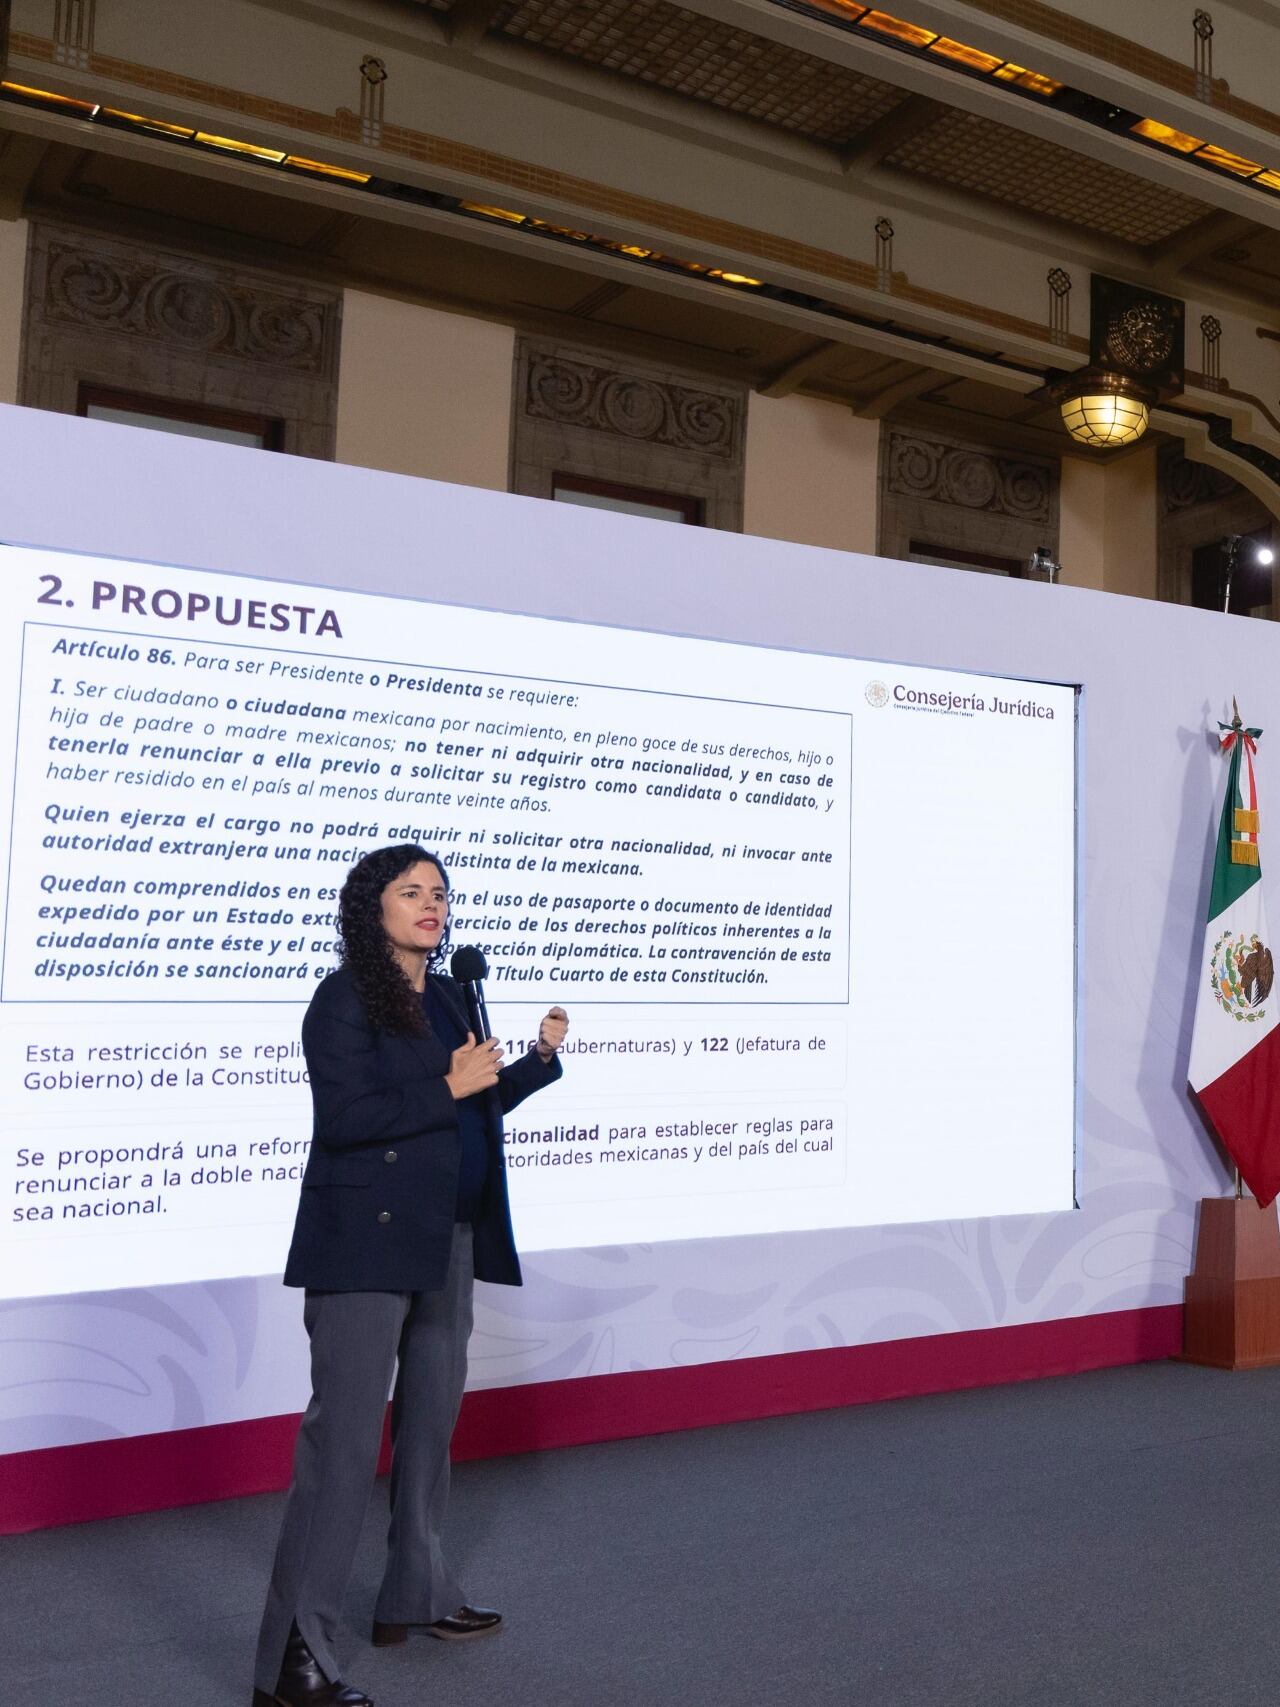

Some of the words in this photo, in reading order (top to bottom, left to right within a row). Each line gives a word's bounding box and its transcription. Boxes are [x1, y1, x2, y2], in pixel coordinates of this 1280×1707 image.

[37, 574, 75, 607] 2.
[92, 581, 343, 638] PROPUESTA
[51, 638, 140, 662] Artículo
[147, 648, 176, 666] 86.
[184, 652, 230, 671] Para
[235, 660, 265, 674] ser
[269, 661, 364, 685] Presidente
[386, 673, 483, 697] Presidenta
[487, 687, 504, 700] se
[509, 690, 579, 708] requiere:
[50, 678, 64, 695] I.
[74, 680, 108, 698] Ser
[114, 685, 219, 708] ciudadano
[244, 697, 347, 720] ciudadana
[352, 710, 436, 728] mexicana
[440, 719, 470, 734] por
[475, 721, 567, 743] nacimiento,
[573, 731, 592, 743] en
[595, 731, 637, 748] pleno
[642, 738, 676, 753] goce
[681, 739, 698, 753] de
[701, 744, 725, 756] sus
[729, 743, 792, 764] derechos,
[797, 750, 822, 768] hijo
[893, 685, 985, 711] Consejería
[989, 697, 1054, 719] Jurídica
[50, 706, 89, 729] hija
[99, 711, 124, 728] de
[133, 716, 193, 734] padre
[225, 724, 287, 741] madre
[296, 731, 396, 753] mexicanos;
[405, 740, 427, 753] no
[436, 741, 484, 757] tener
[491, 746, 509, 760] ni
[515, 748, 584, 768] adquirir
[590, 755, 624, 770] otra
[631, 759, 733, 781] nacionalidad,
[755, 771, 773, 782] en
[779, 773, 811, 785] caso
[817, 774, 833, 788] de
[46, 761, 109, 782] haber
[114, 769, 195, 788] residido
[202, 777, 225, 790] en
[231, 775, 248, 791] el
[251, 778, 291, 796] país
[297, 780, 315, 796] al
[319, 785, 378, 800] menos
[384, 786, 452, 805] durante
[457, 792, 505, 809] veinte
[510, 796, 551, 812] años.
[48, 736, 129, 756] tenerla
[140, 744, 243, 764] renunciar
[275, 752, 312, 770] ella
[320, 758, 381, 775] previo
[410, 763, 485, 782] solicitar
[492, 772, 512, 785] su
[520, 773, 586, 791] registro
[595, 780, 637, 794] como
[646, 783, 722, 801] candidata
[745, 791, 818, 810] candidato,
[42, 834, 154, 853] autoridad
[159, 840, 269, 861] extranjera
[274, 846, 311, 860] una
[444, 851, 512, 870] distinta
[516, 855, 536, 871] de
[541, 857, 557, 871] la
[562, 859, 644, 876] mexicana.
[45, 804, 109, 824] Quien
[120, 808, 186, 830] ejerza
[196, 813, 215, 829] el
[224, 818, 281, 836] cargo
[290, 821, 314, 834] no
[321, 821, 379, 840] podrá
[387, 824, 462, 846] adquirir
[468, 829, 486, 843] ni
[492, 831, 563, 848] solicitar
[569, 836, 604, 850] otra
[610, 838, 714, 859] nacionalidad,
[722, 844, 737, 858] ni
[742, 845, 796, 861] invocar
[801, 850, 832, 863] ante
[40, 875, 126, 894] Quedan
[133, 880, 281, 900] comprendidos
[287, 886, 311, 900] en
[472, 890, 489, 906] el
[493, 894, 523, 907] uso
[528, 892, 548, 908] de
[552, 897, 636, 914] pasaporte
[654, 897, 739, 915] documento
[743, 901, 761, 916] de
[764, 901, 833, 918] identidad
[38, 904, 140, 925] expedido
[146, 909, 185, 927] por
[193, 910, 218, 923] un
[226, 908, 294, 925] Estado
[518, 916, 539, 931] de
[544, 917, 568, 932] los
[574, 918, 647, 934] derechos
[651, 921, 718, 939] políticos
[722, 923, 800, 939] inherentes
[818, 926, 832, 939] la
[36, 931, 160, 950] ciudadanía
[166, 936, 214, 951] ante
[221, 934, 264, 951] éste
[287, 936, 305, 952] el
[542, 942, 643, 961] diplomática.
[648, 944, 667, 959] La
[670, 947, 776, 961] contravención
[780, 947, 798, 961] de
[801, 949, 831, 962] esta
[34, 959, 159, 981] disposición
[165, 964, 189, 978] se
[194, 961, 308, 979] sancionará
[496, 965, 544, 981] Título
[549, 967, 604, 982] Cuarto
[609, 967, 629, 982] de
[633, 969, 667, 982] esta
[671, 968, 768, 984] Constitución.
[26, 1045, 74, 1062] Esta
[88, 1042, 207, 1061] restricción
[219, 1046, 242, 1059] se
[701, 1037, 729, 1052] 122
[736, 1036, 800, 1055] (Jefatura
[808, 1036, 826, 1050] de
[24, 1070, 143, 1090] Gobierno)
[150, 1069, 178, 1086] de
[186, 1067, 204, 1086] la
[15, 1172, 132, 1194] renunciar
[163, 1168, 181, 1187] la
[191, 1165, 253, 1185] doble
[600, 1146, 688, 1163] mexicanas
[708, 1141, 732, 1157] del
[738, 1140, 769, 1160] país
[775, 1138, 797, 1154] del
[803, 1136, 833, 1152] cual
[16, 1148, 45, 1167] Se
[58, 1141, 183, 1171] propondrá
[196, 1144, 237, 1159] una
[609, 1126, 646, 1144] para
[655, 1120, 739, 1138] establecer
[746, 1117, 793, 1137] reglas
[800, 1119, 833, 1136] para
[13, 1206, 54, 1222] sea
[63, 1195, 167, 1219] nacional.
